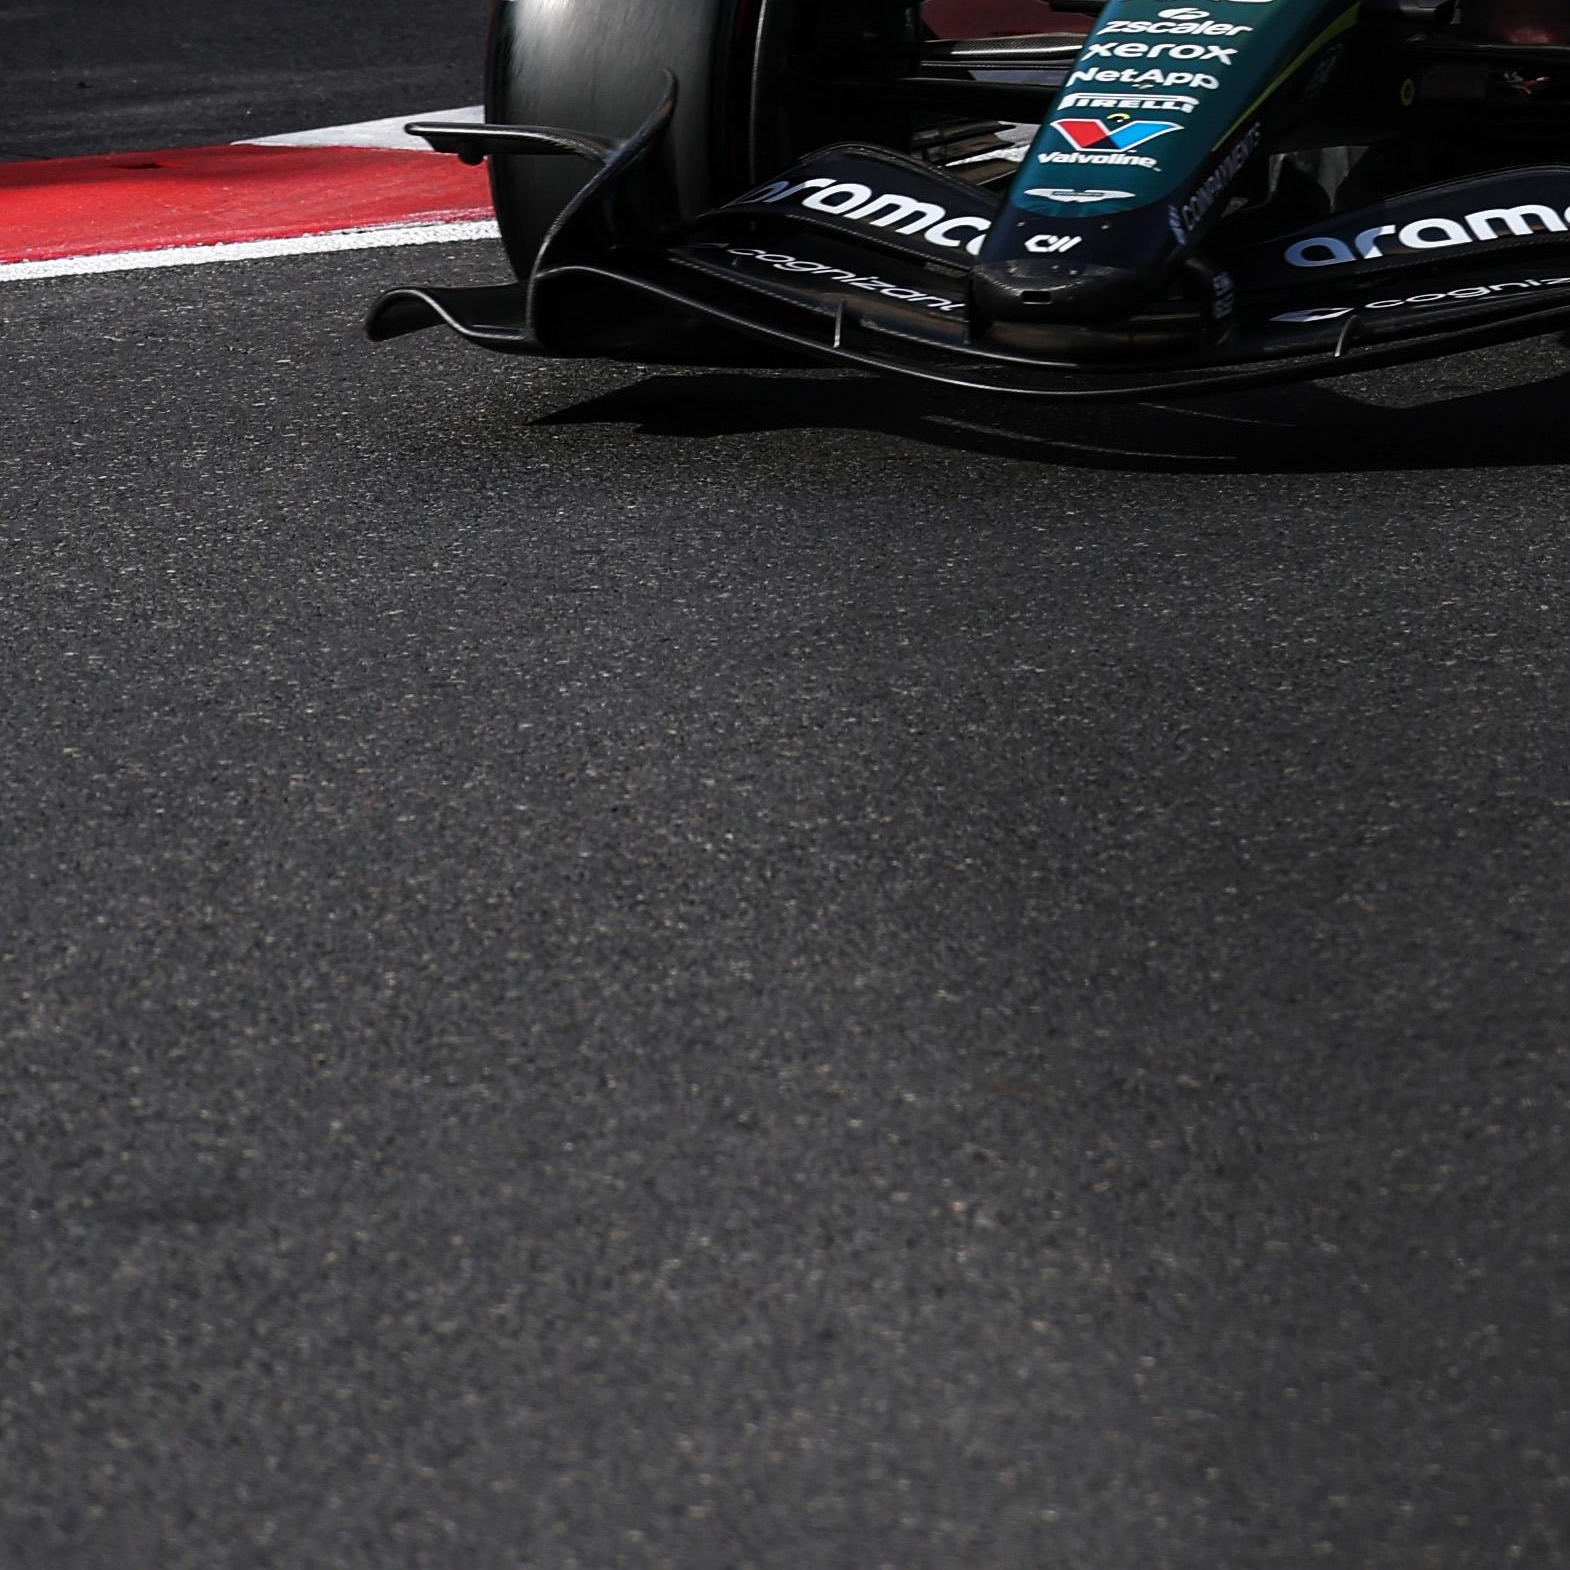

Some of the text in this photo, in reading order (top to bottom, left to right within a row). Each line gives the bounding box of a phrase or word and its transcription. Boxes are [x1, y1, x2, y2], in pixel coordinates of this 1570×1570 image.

[1096, 20, 1254, 37] zscaler
[1080, 41, 1239, 66] xerox
[1065, 66, 1220, 91] NetApp
[1056, 92, 1200, 114] PIRELLI
[1037, 151, 1158, 169] Valvoline
[725, 246, 967, 313] cognizant
